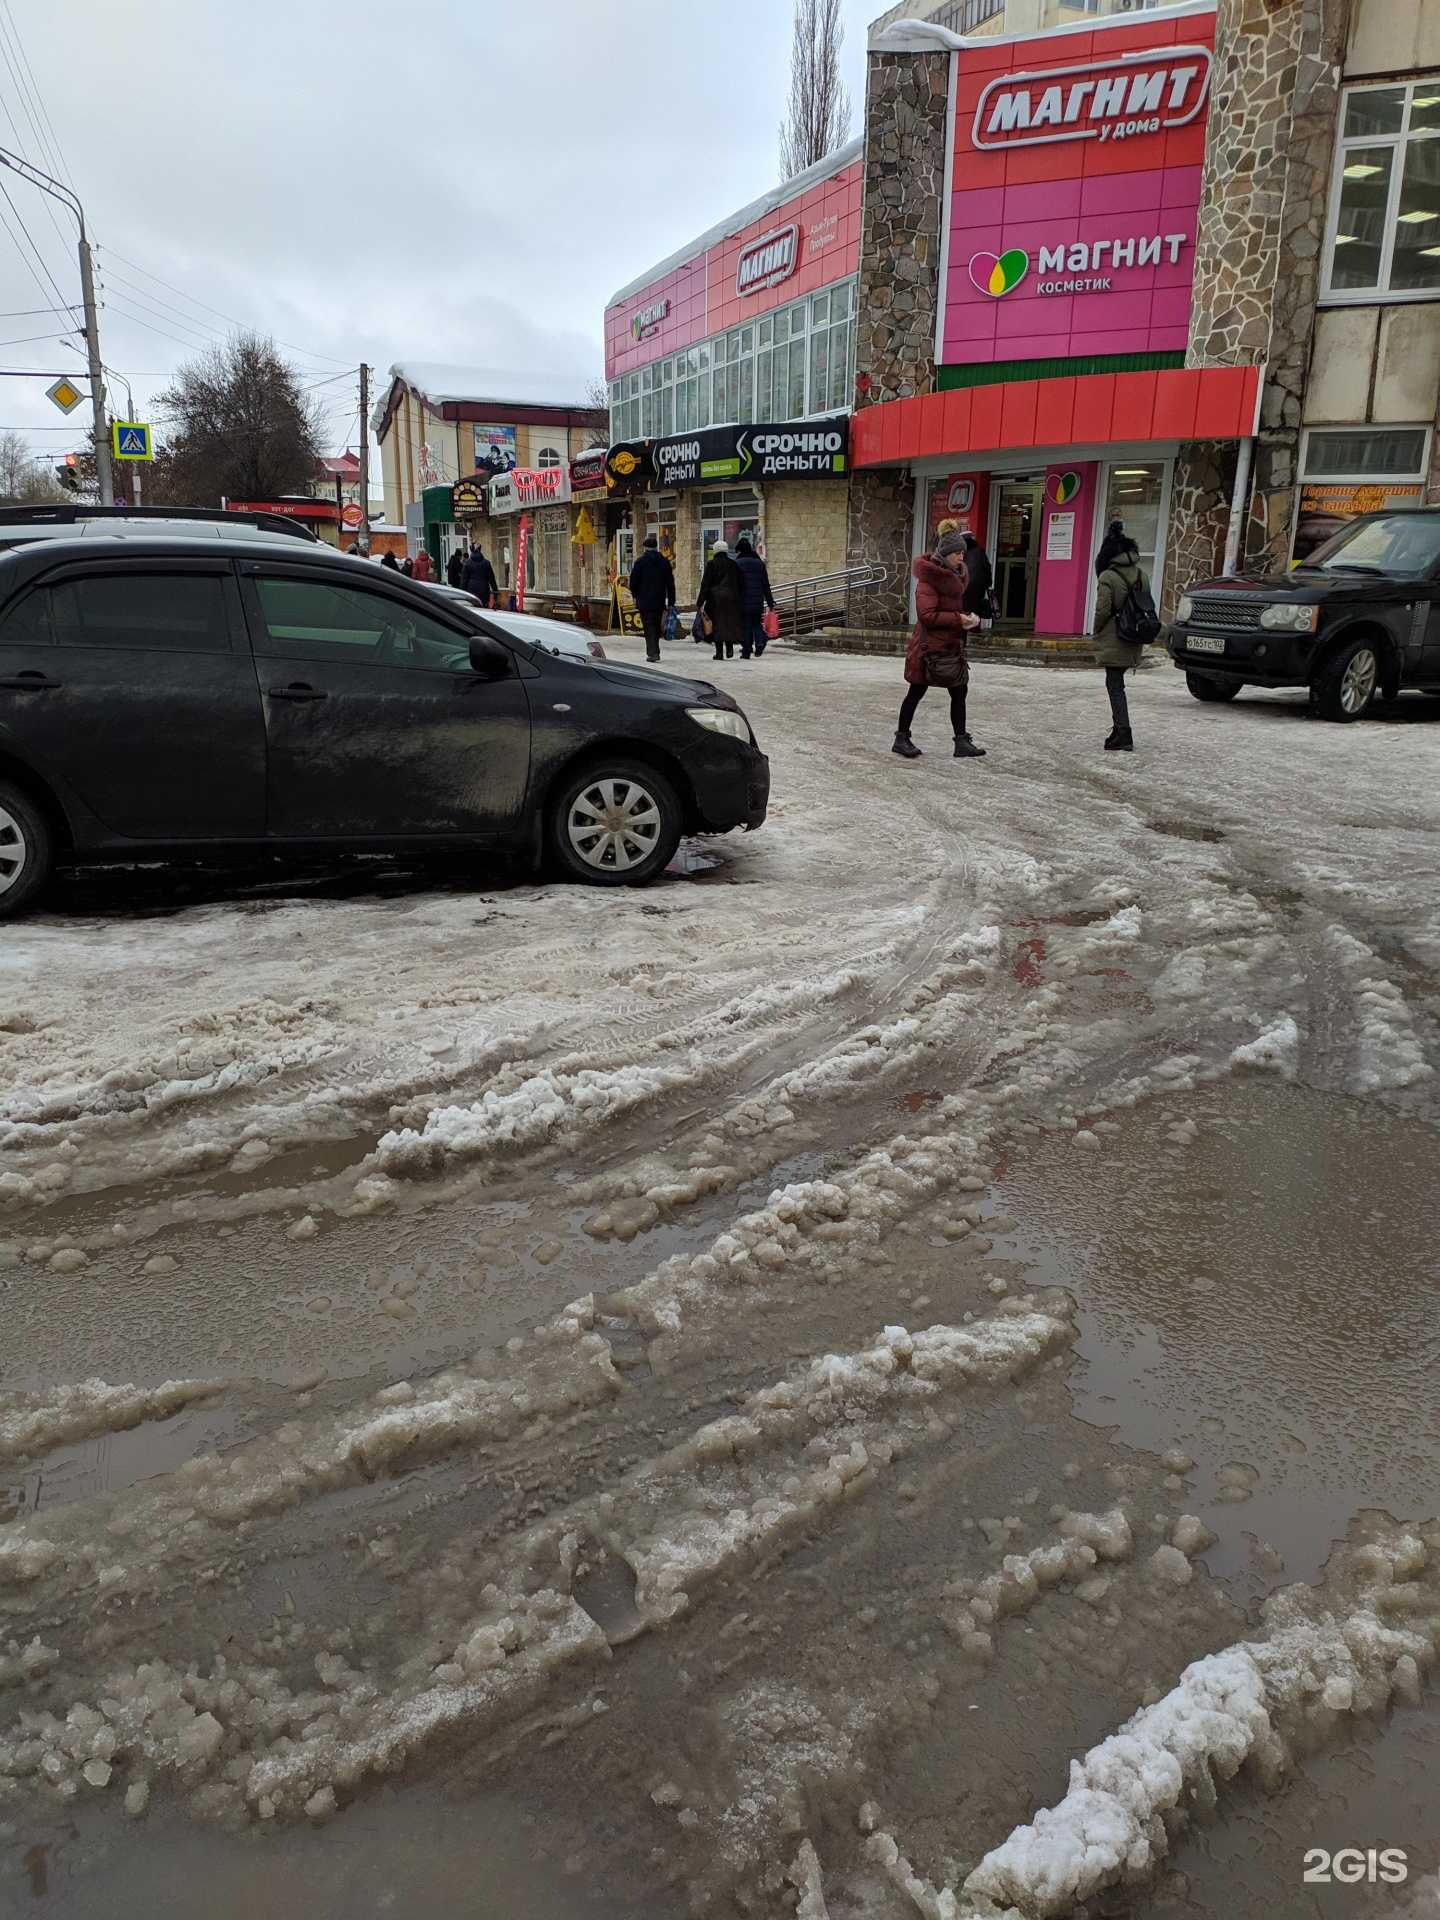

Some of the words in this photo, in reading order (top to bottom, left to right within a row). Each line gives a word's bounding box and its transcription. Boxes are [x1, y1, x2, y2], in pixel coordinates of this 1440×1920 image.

[986, 66, 1198, 133] МАГНИТ
[1098, 124, 1111, 142] у
[1112, 117, 1160, 141] дома
[739, 237, 792, 286] МАГНИТ
[1037, 233, 1187, 275] магнит
[1036, 277, 1112, 295] косметик
[659, 440, 701, 465] СРОЧНО
[752, 432, 842, 454] СРОЧНО
[664, 464, 696, 484] деньги
[762, 455, 830, 474] деньги
